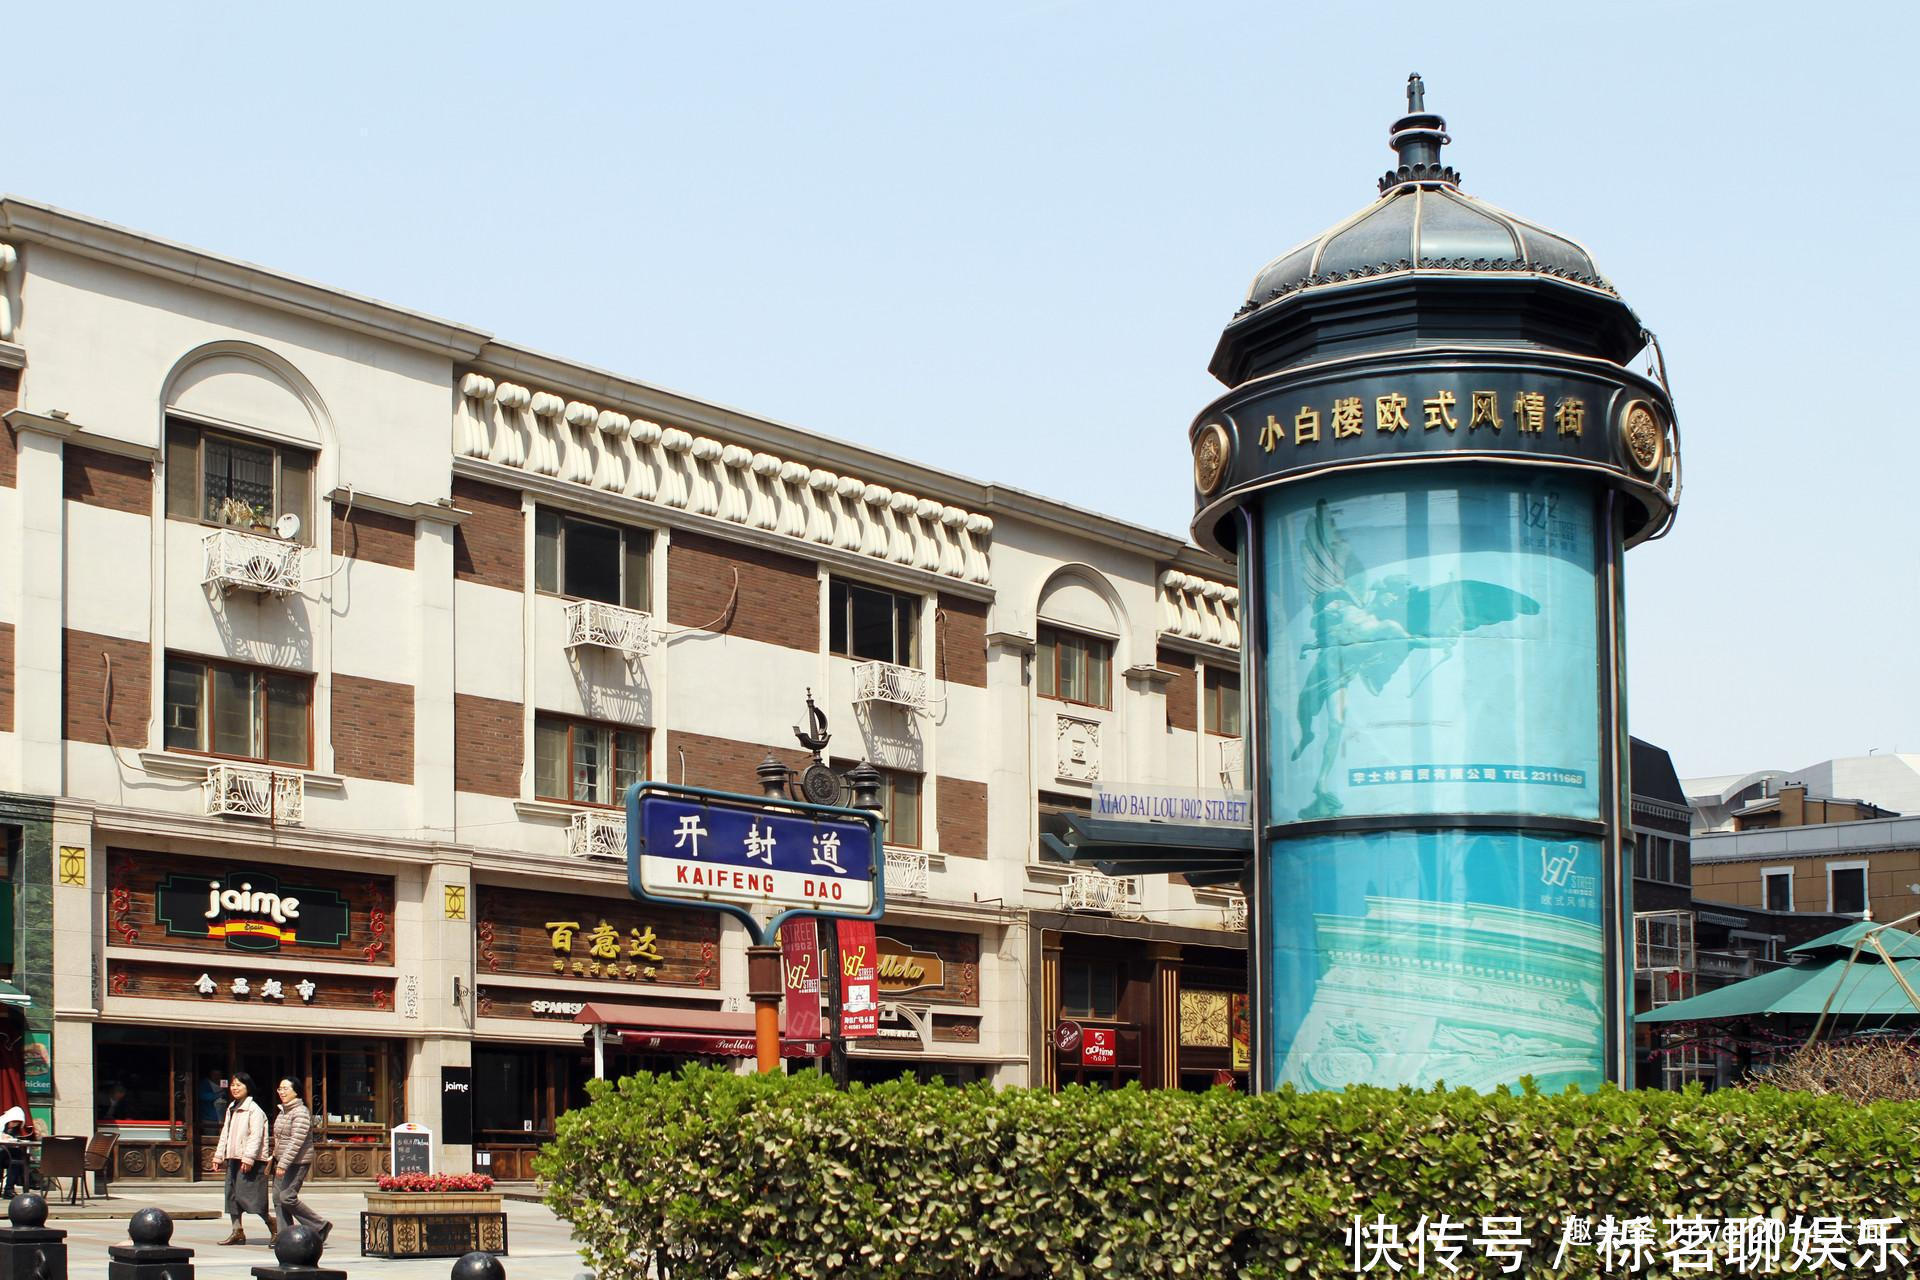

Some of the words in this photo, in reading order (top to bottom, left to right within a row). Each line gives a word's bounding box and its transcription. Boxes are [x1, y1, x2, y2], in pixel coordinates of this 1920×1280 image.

[1258, 391, 1585, 453] 小白楼欧式风情街
[1504, 770, 1528, 780] TEL
[1098, 793, 1128, 814] XIAO
[1130, 795, 1150, 817] BAI
[1154, 797, 1177, 818] LOU
[1180, 799, 1202, 819] 1902
[1205, 800, 1248, 822] STREET
[673, 815, 847, 874] 开封道
[677, 865, 774, 893] KAIFENG
[804, 880, 842, 900] DAO
[205, 881, 299, 923] jaime
[545, 919, 664, 961] 百意达
[194, 973, 316, 1001] 食品超市
[445, 1081, 468, 1092] jaime
